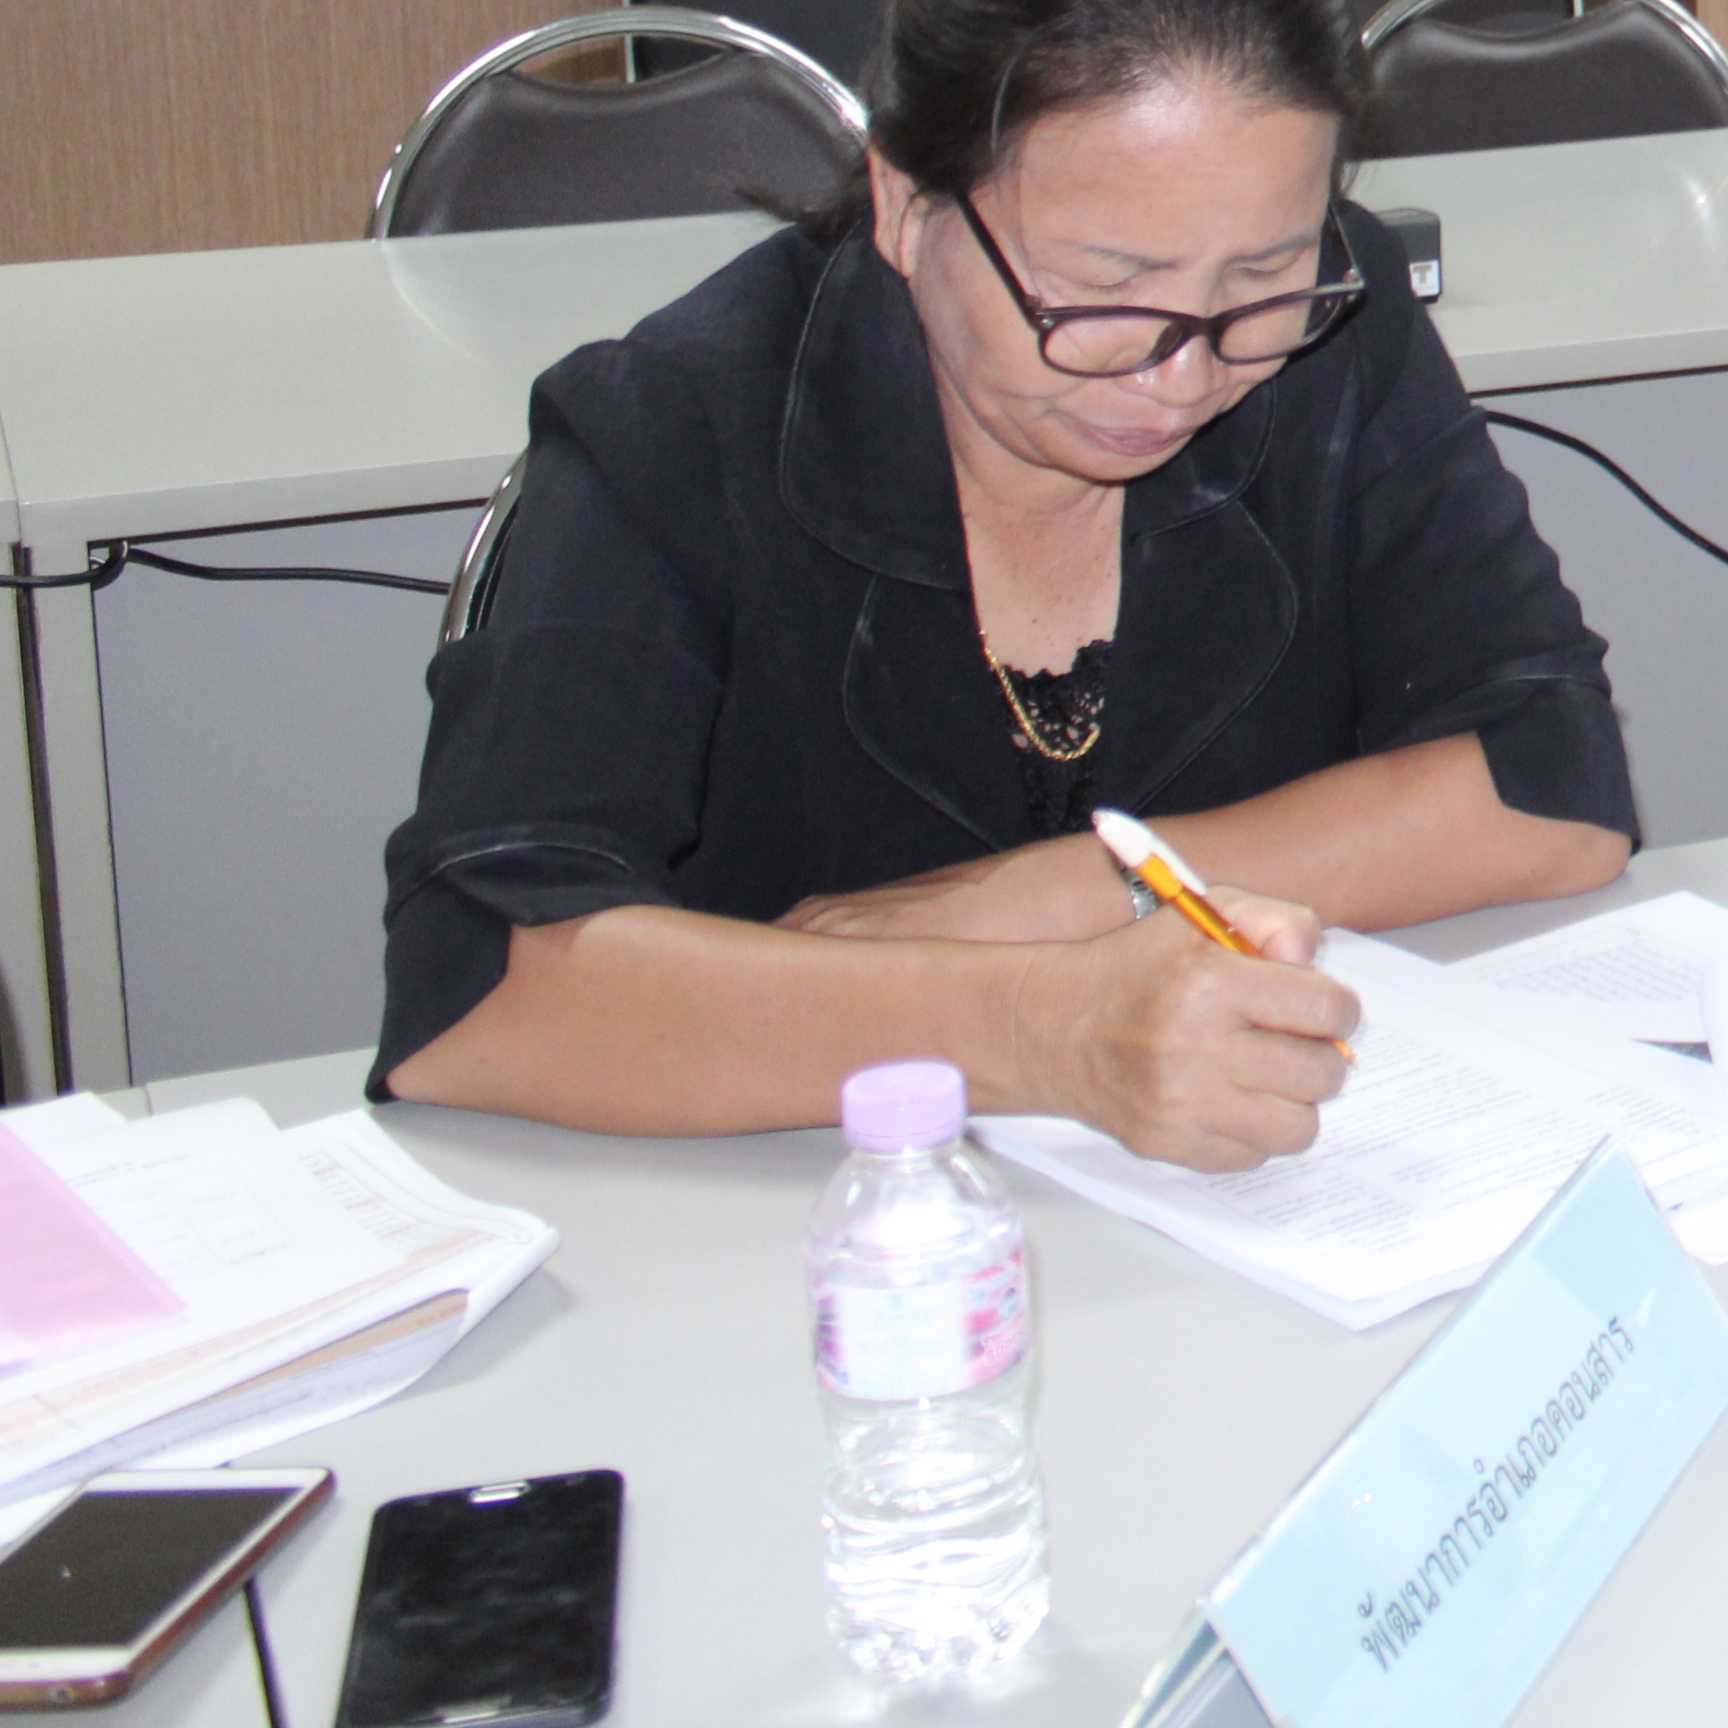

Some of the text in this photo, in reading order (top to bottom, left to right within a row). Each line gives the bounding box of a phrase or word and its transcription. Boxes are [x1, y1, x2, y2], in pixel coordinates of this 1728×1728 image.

[1357, 1315, 1634, 1674] พัฒนาการอำเภอคอนสาร
